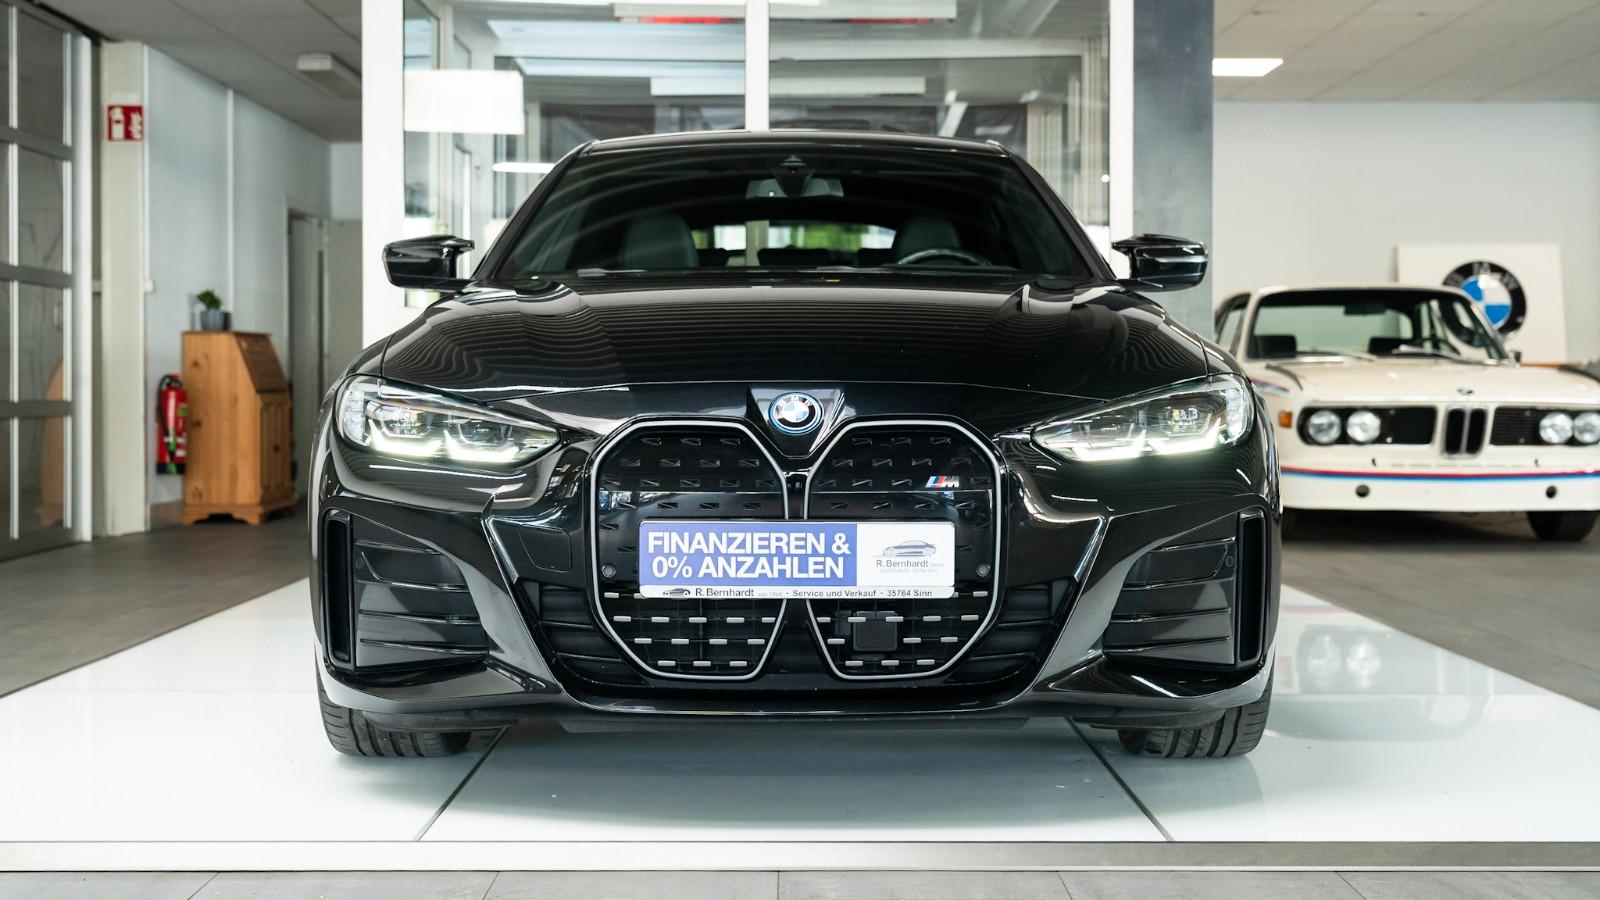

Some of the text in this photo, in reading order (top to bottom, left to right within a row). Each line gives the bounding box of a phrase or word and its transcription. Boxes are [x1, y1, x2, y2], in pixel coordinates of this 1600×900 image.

[648, 532, 851, 555] FINANZIEREN &
[652, 556, 844, 579] 0% ANZAHLEN
[706, 587, 755, 597] Bernhardt
[792, 589, 822, 598] Service
[826, 589, 842, 597] und
[844, 589, 876, 597] Verkauf
[887, 589, 911, 597] 35764
[913, 589, 933, 597] Sinn
